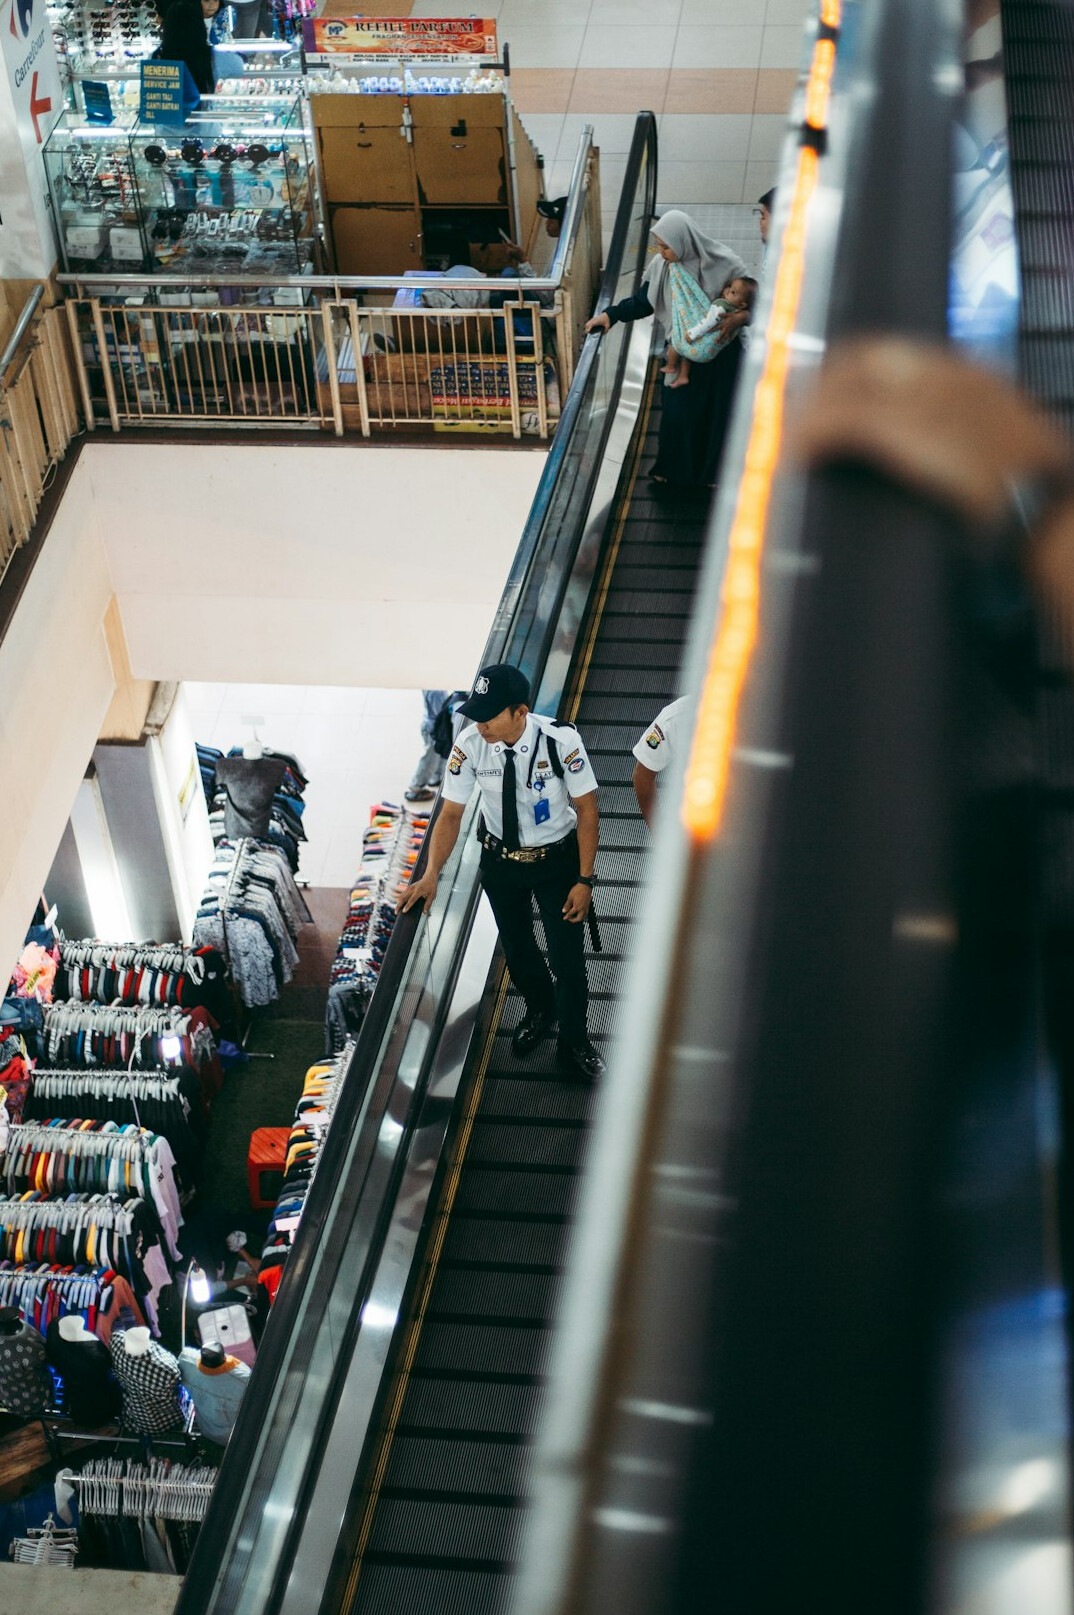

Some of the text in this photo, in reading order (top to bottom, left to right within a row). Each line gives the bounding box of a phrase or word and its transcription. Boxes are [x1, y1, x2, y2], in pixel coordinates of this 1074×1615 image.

[355, 22, 406, 32] REFILL
[15, 28, 45, 88] Carrefour
[143, 65, 180, 77] MENERIMA
[143, 80, 180, 89] SERVICE JAM
